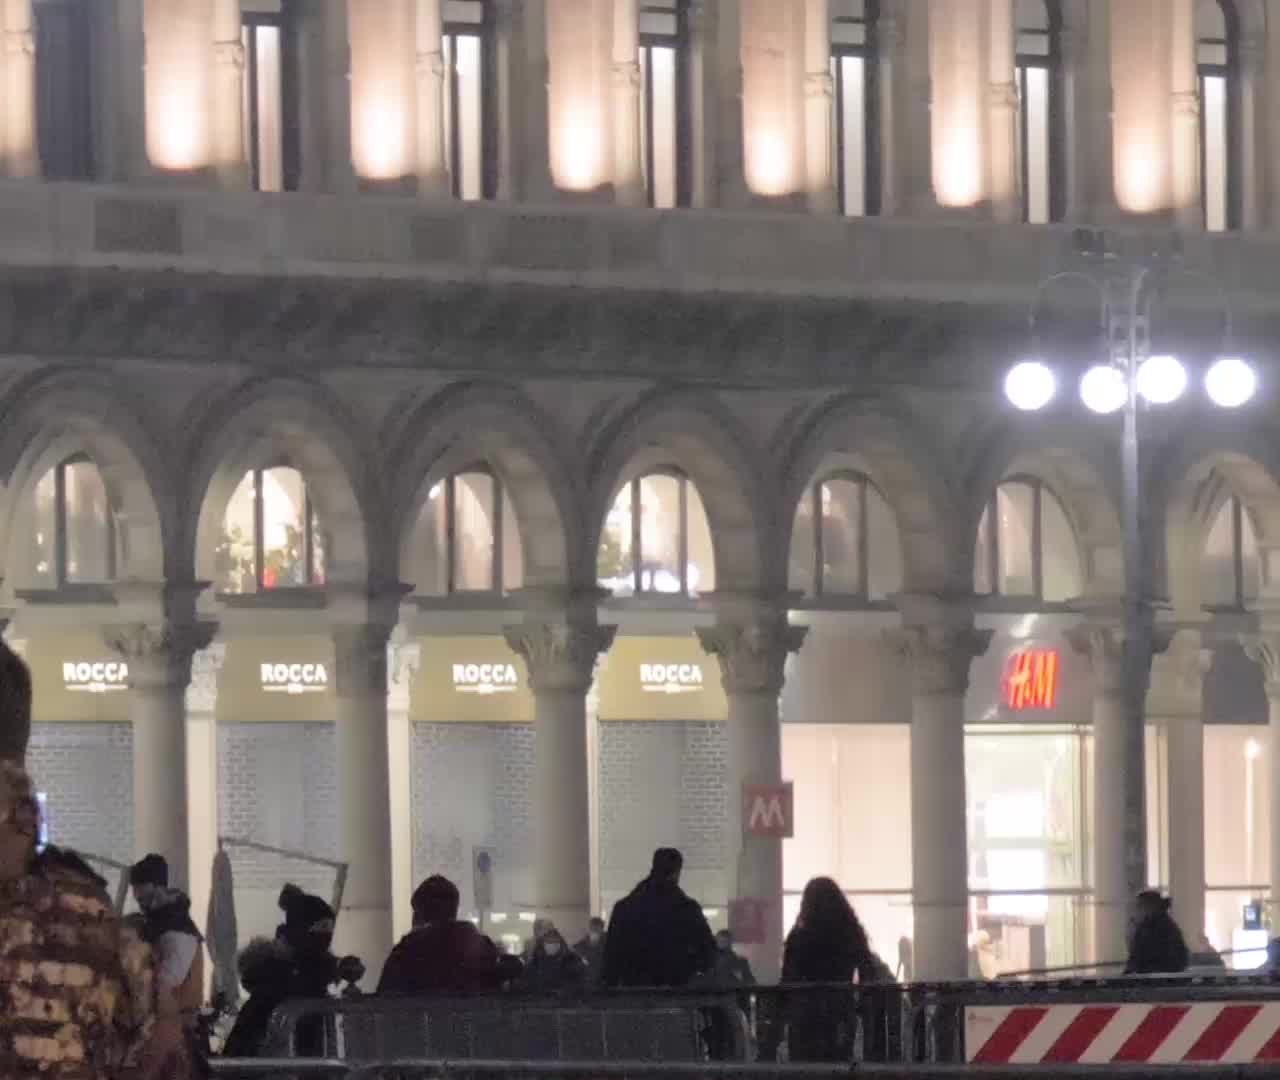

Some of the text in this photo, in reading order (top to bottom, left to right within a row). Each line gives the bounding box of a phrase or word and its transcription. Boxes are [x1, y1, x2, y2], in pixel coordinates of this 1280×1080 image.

[63, 662, 128, 681] ROCCA
[261, 663, 327, 683] ROCCA
[453, 663, 517, 683] ROCCA
[640, 663, 703, 683] ROCCA
[749, 795, 785, 830] M
